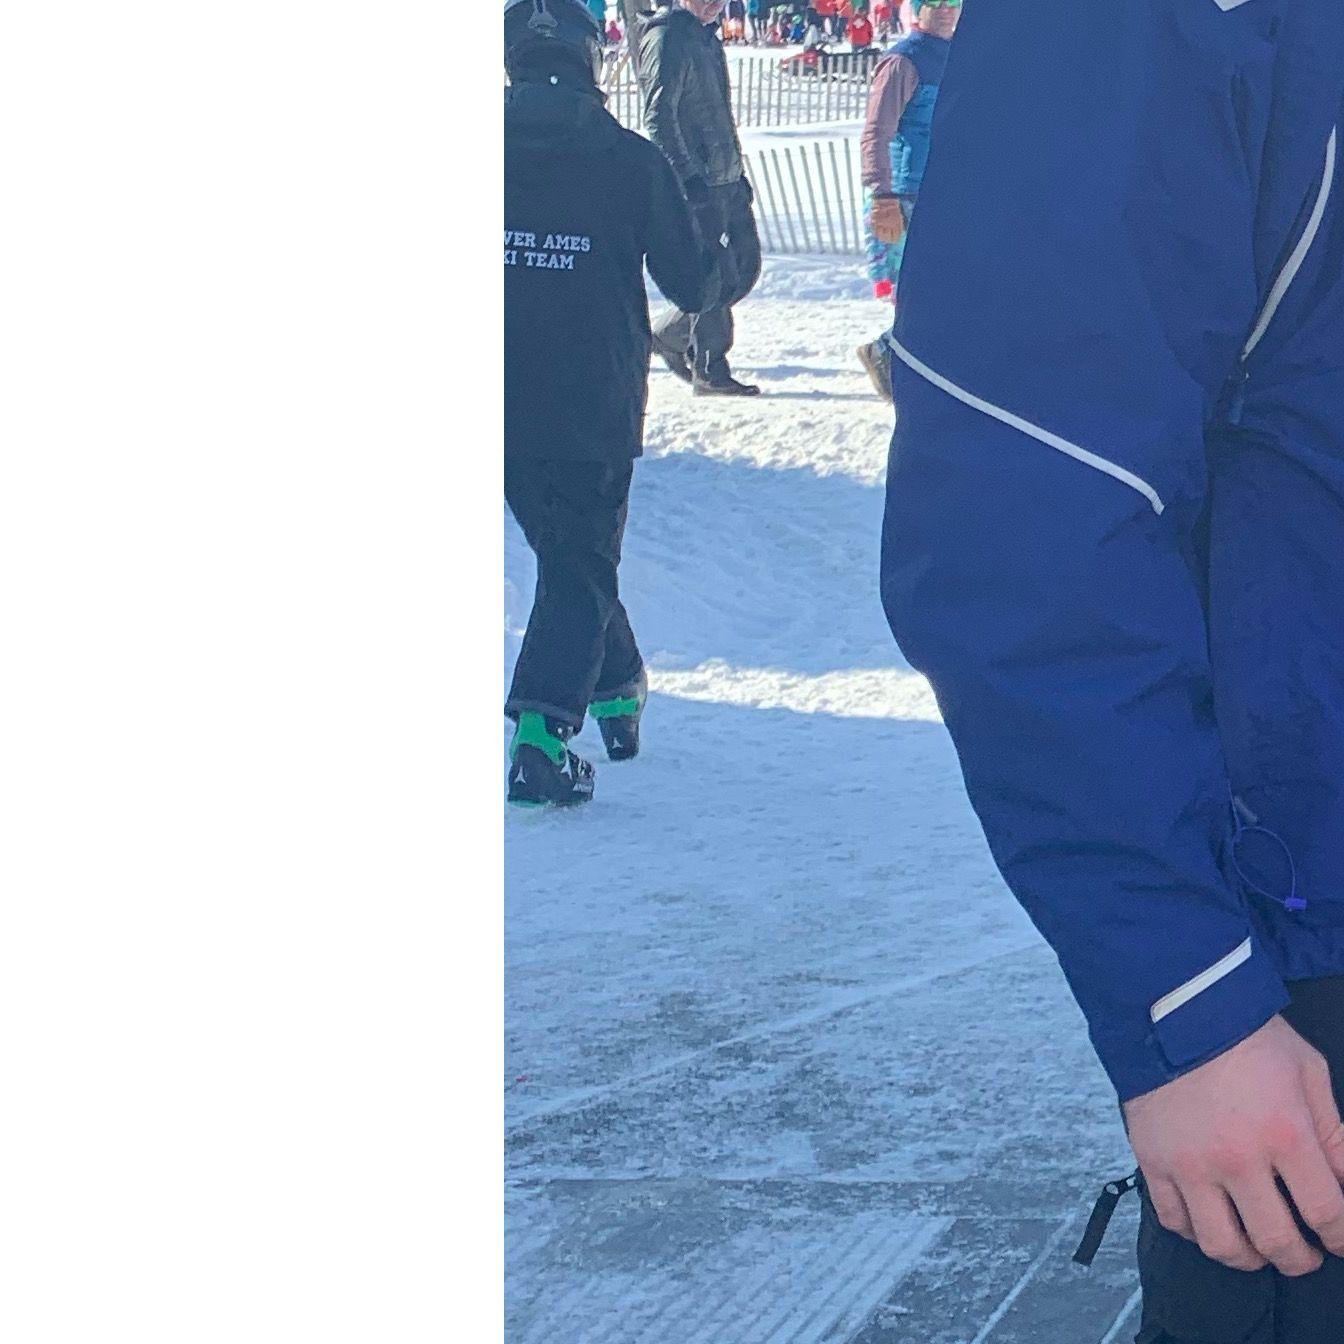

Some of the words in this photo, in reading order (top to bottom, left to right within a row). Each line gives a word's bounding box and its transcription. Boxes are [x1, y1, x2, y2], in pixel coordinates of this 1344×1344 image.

[504, 230, 536, 248] VER
[542, 233, 591, 252] AMES
[524, 251, 575, 270] TEAM
